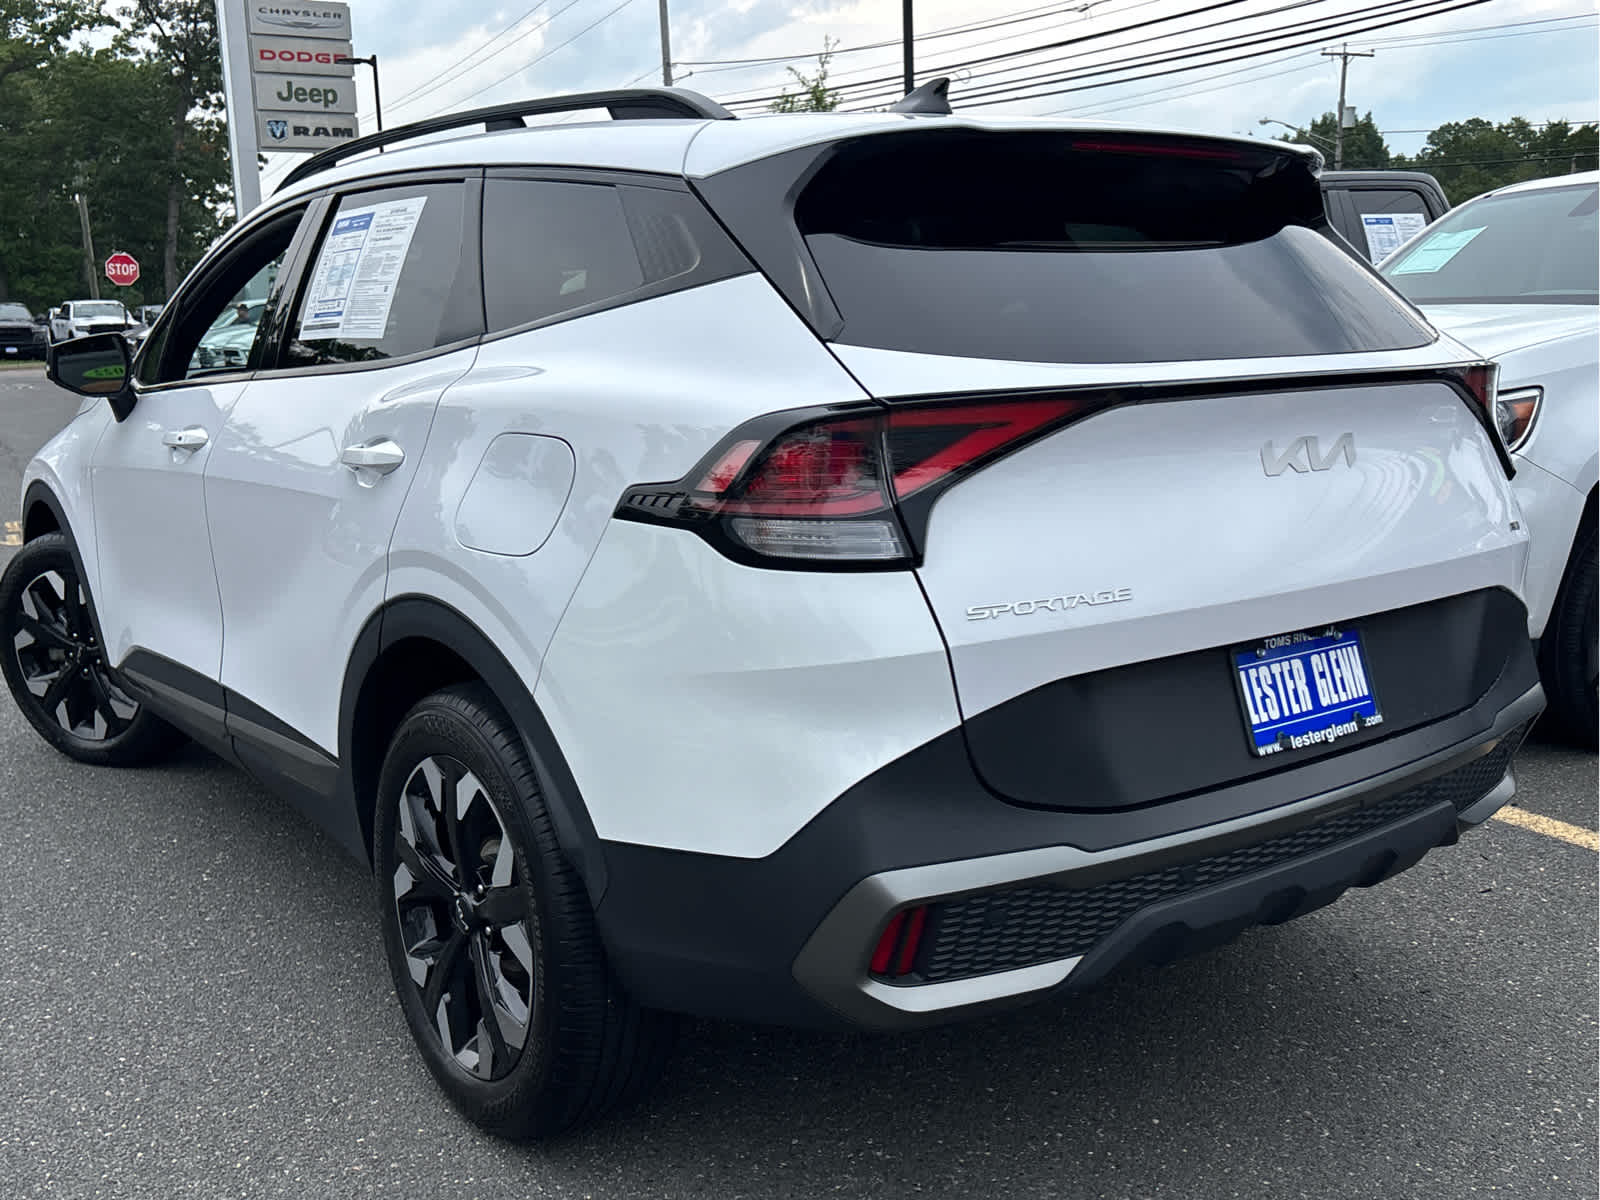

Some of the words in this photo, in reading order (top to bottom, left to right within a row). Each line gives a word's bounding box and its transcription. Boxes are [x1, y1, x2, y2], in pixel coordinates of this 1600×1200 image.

[258, 7, 342, 19] CHRYSLER
[277, 81, 338, 108] Jeep
[293, 126, 353, 138] RAM
[108, 263, 137, 276] STOP
[1260, 432, 1357, 478] KIA
[966, 587, 1133, 620] SPORTAGE
[1264, 635, 1292, 649] TOMS
[1239, 658, 1313, 725] LESTER
[1310, 645, 1369, 707] GLENN
